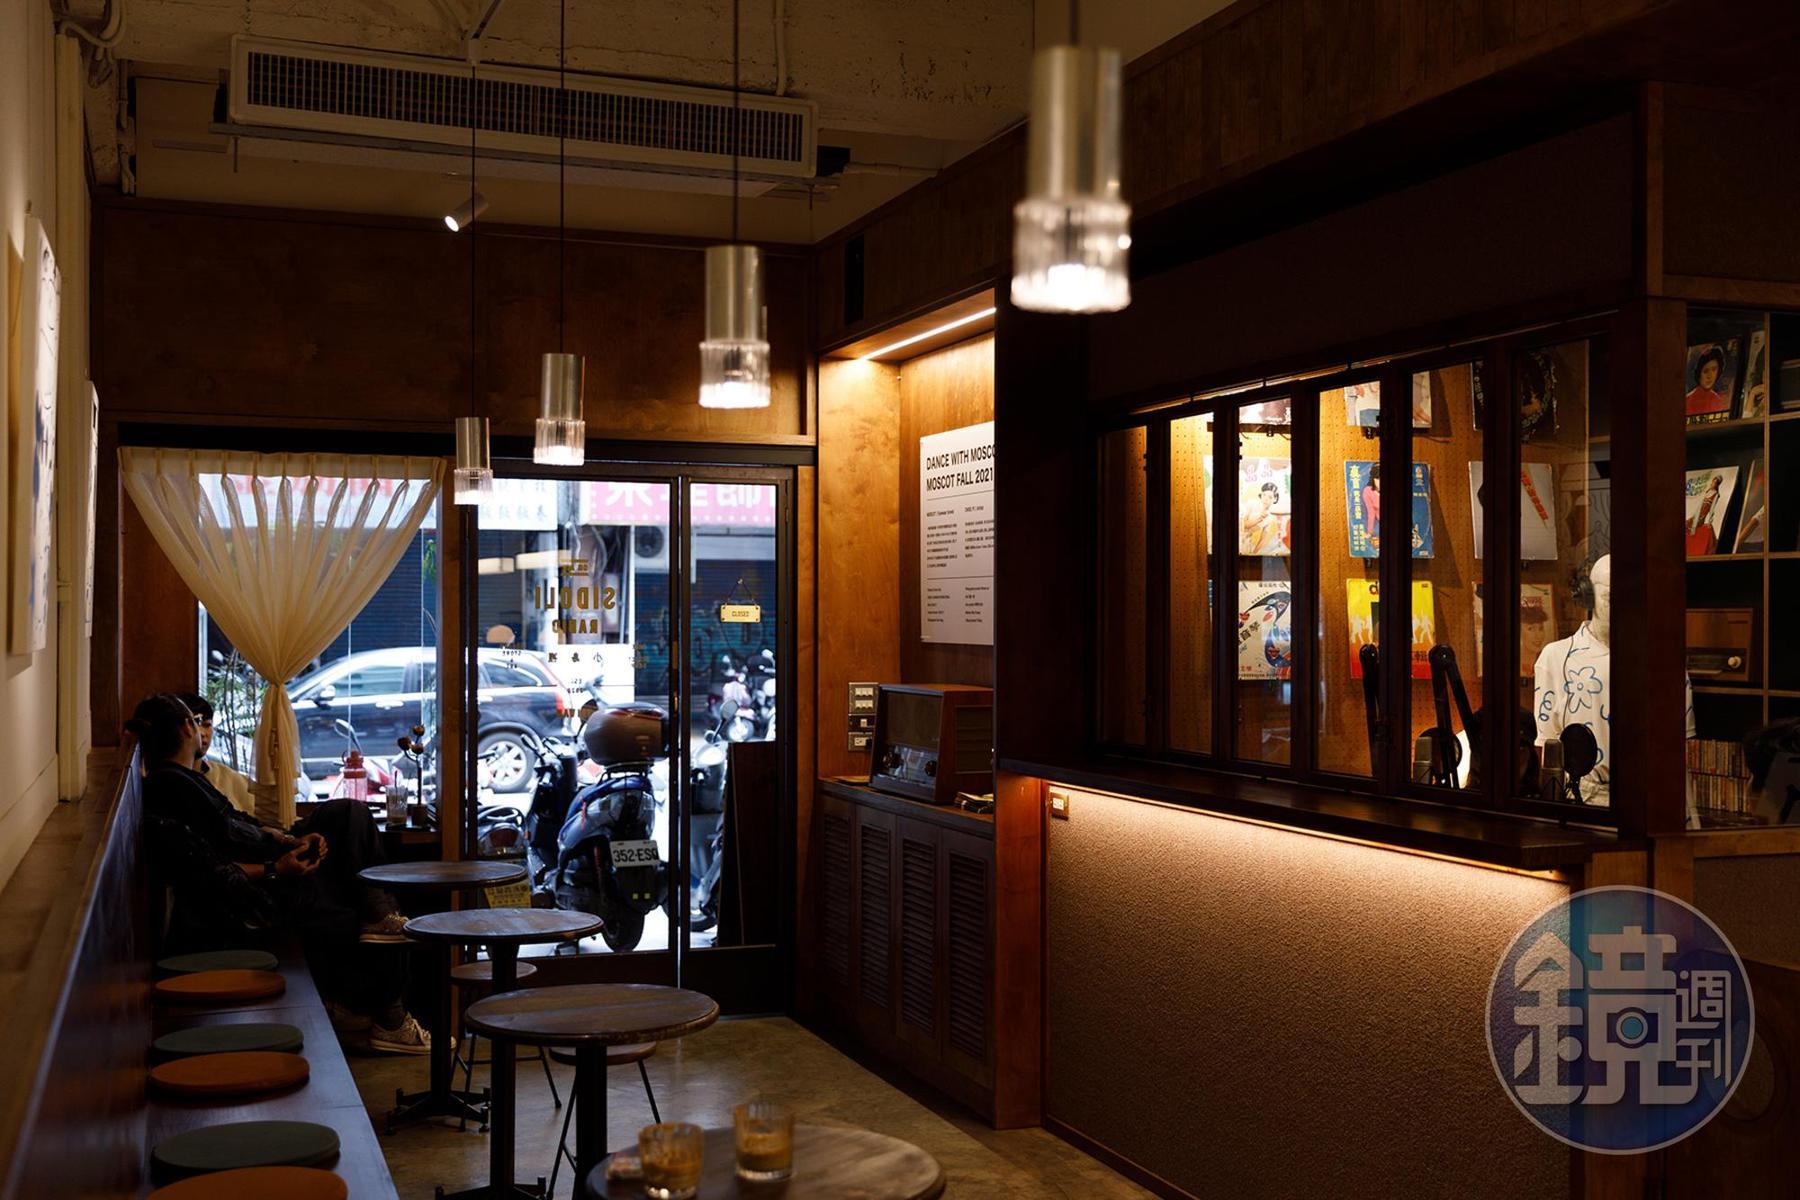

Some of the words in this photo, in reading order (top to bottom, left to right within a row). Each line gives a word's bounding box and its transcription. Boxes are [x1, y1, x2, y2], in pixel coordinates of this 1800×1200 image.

[927, 453, 949, 470] DANCE
[951, 449, 969, 465] WITH
[927, 473, 955, 491] MOSCOT
[956, 471, 974, 486] FALL
[975, 467, 993, 484] 2021
